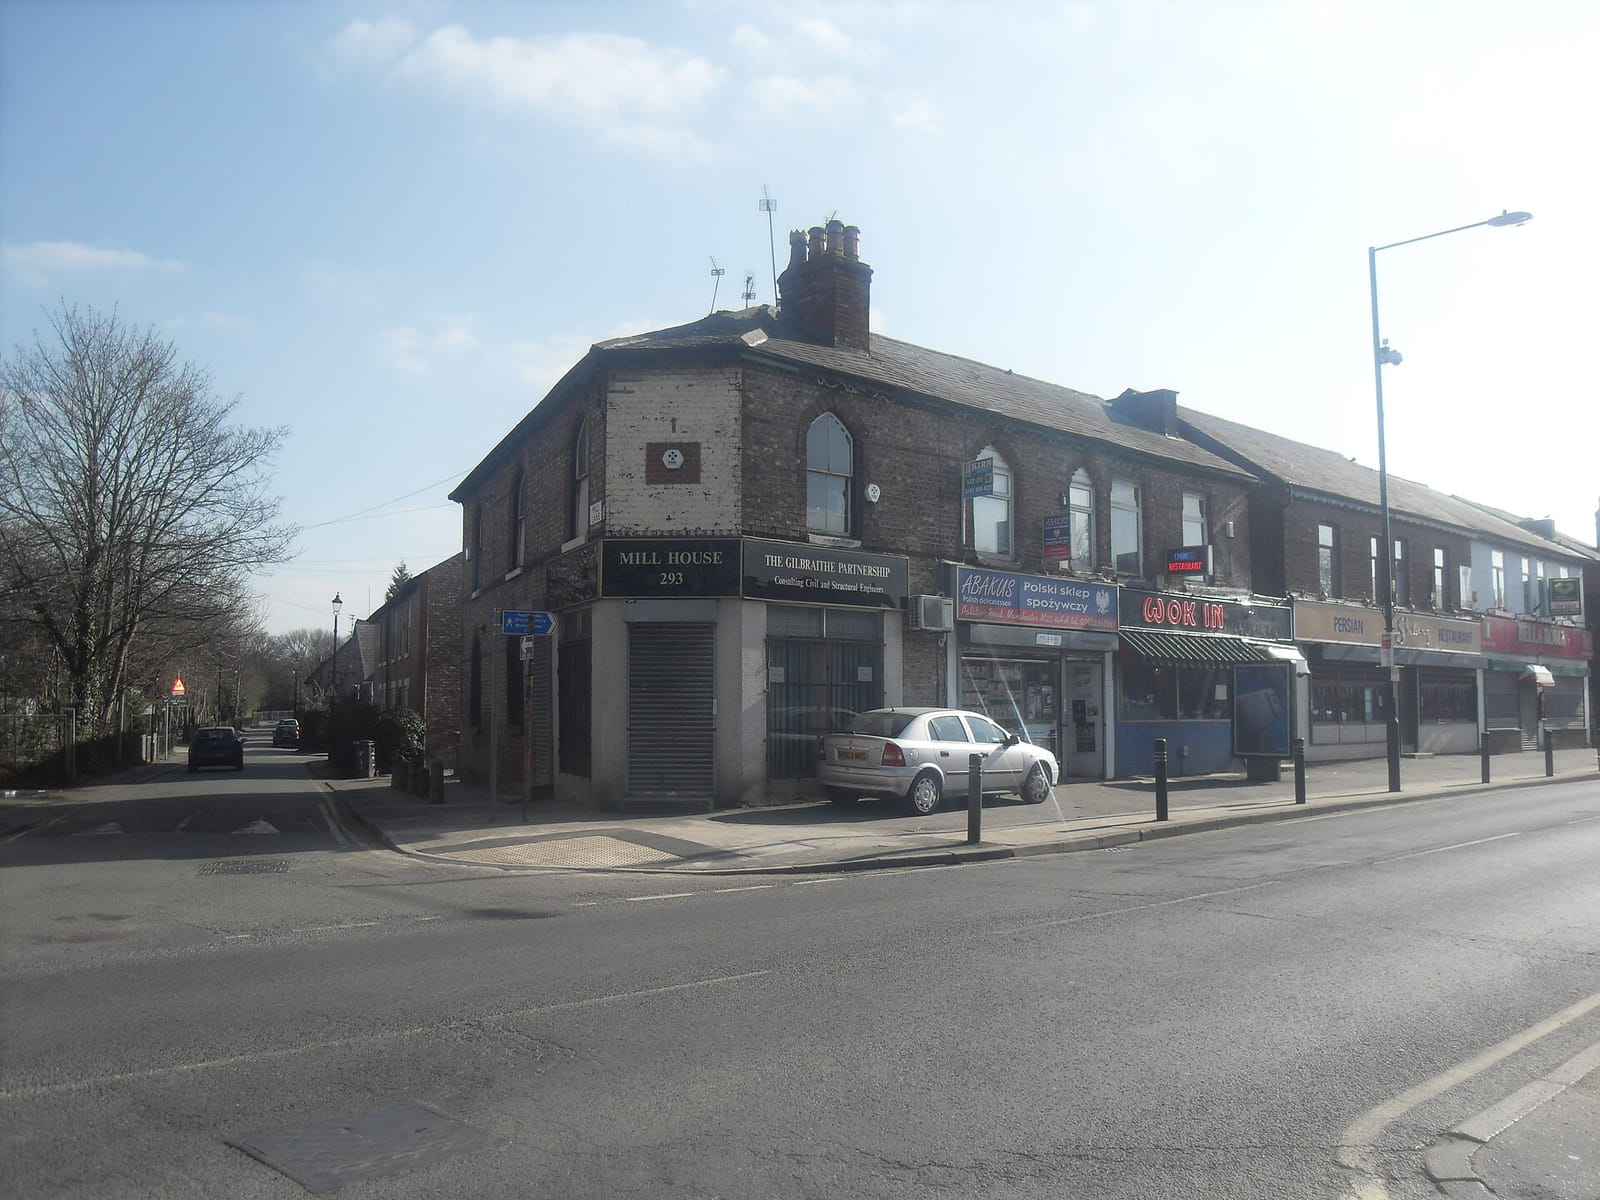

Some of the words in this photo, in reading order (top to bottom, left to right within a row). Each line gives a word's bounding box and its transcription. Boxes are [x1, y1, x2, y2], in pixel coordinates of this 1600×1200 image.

[619, 552, 661, 565] MILL
[668, 552, 723, 565] HOUSE
[764, 554, 784, 568] THE
[785, 556, 836, 573] GILBRAITHE
[838, 562, 891, 578] PARTNERSHIP
[1168, 561, 1203, 571] RESTAURANT
[659, 572, 684, 585] 293
[774, 575, 805, 588] Consulting
[805, 578, 819, 588] Civil
[820, 581, 830, 589] and
[831, 580, 858, 592] Structural
[859, 583, 884, 594] Engineers
[961, 574, 1016, 598] ABAKUS
[1023, 581, 1057, 595] Polski
[1060, 586, 1090, 599] sklep
[1026, 597, 1088, 614] spożywczy
[1143, 597, 1196, 626] WOK
[1203, 602, 1224, 629] IN
[1334, 616, 1364, 635] PERSIAN
[1438, 628, 1473, 644] RESTAURANT
